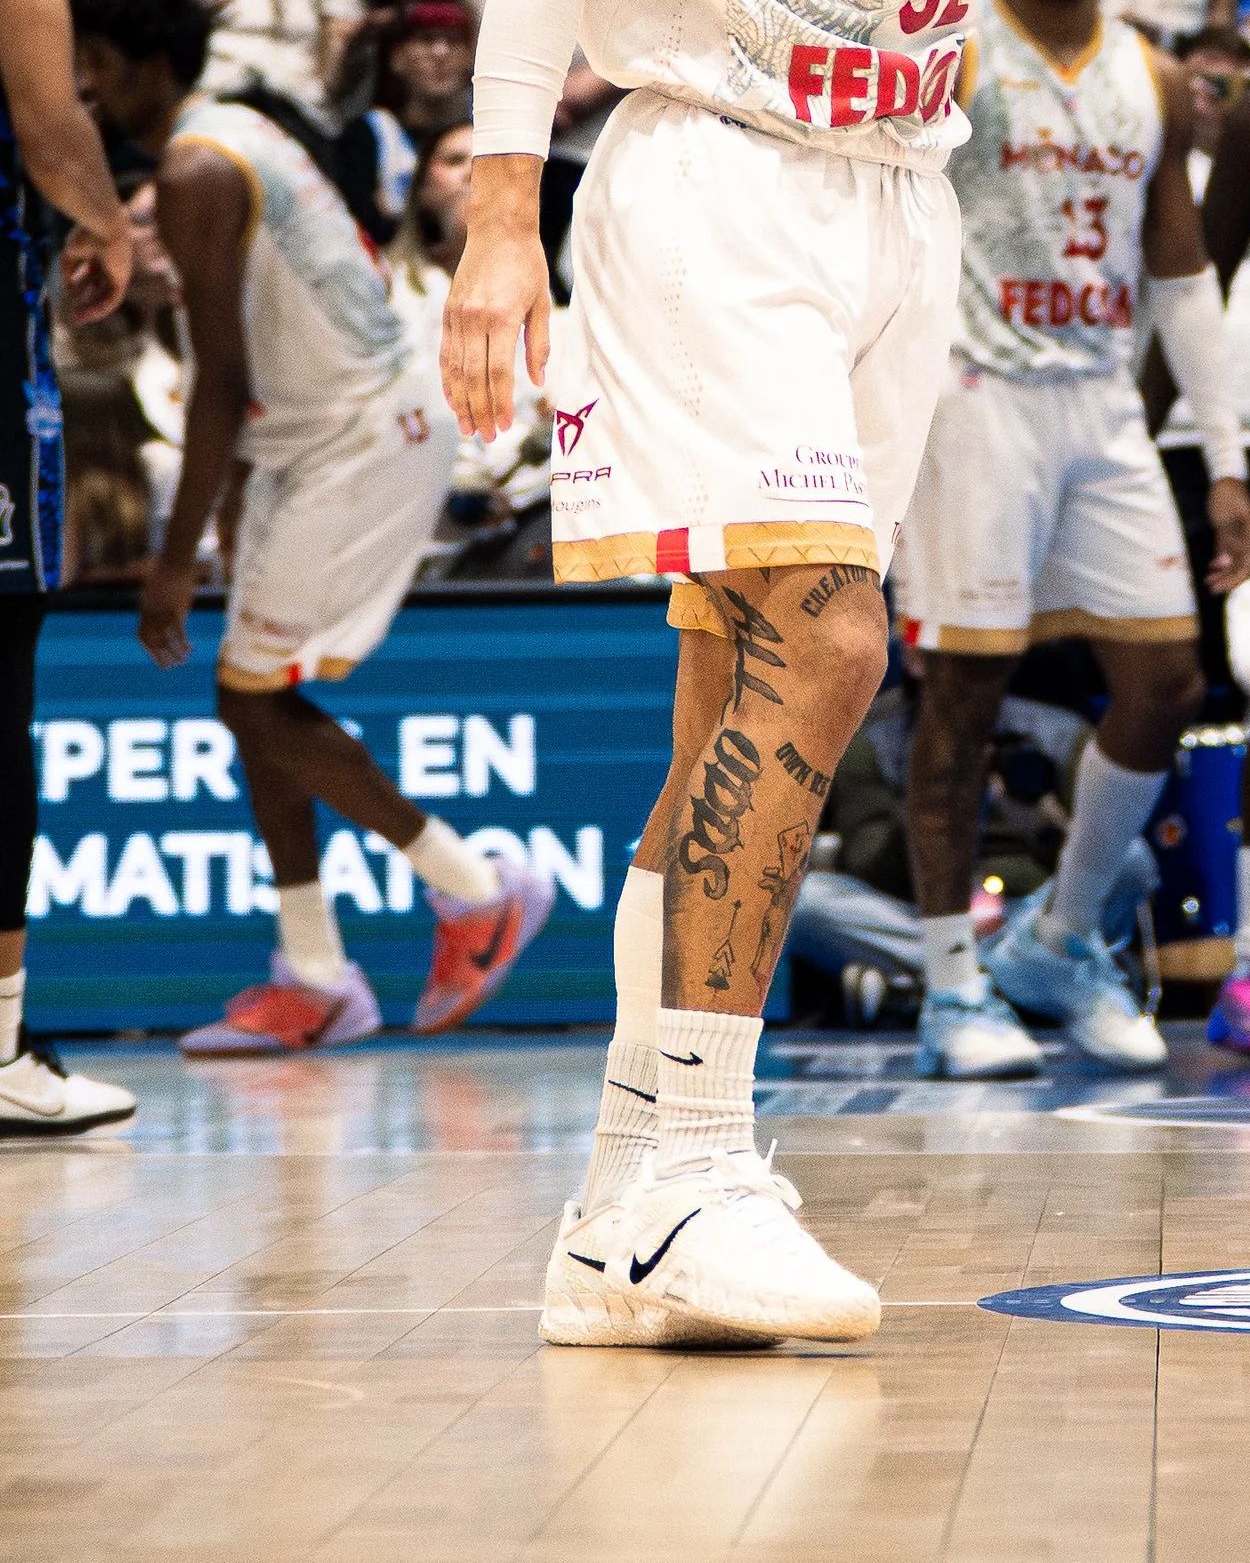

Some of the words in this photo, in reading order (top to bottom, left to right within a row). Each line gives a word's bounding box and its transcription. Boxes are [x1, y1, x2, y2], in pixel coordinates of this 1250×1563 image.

[549, 466, 612, 486] PRA
[759, 468, 841, 489] MICHEL
[552, 498, 602, 514] ougins
[399, 713, 536, 799] EN
